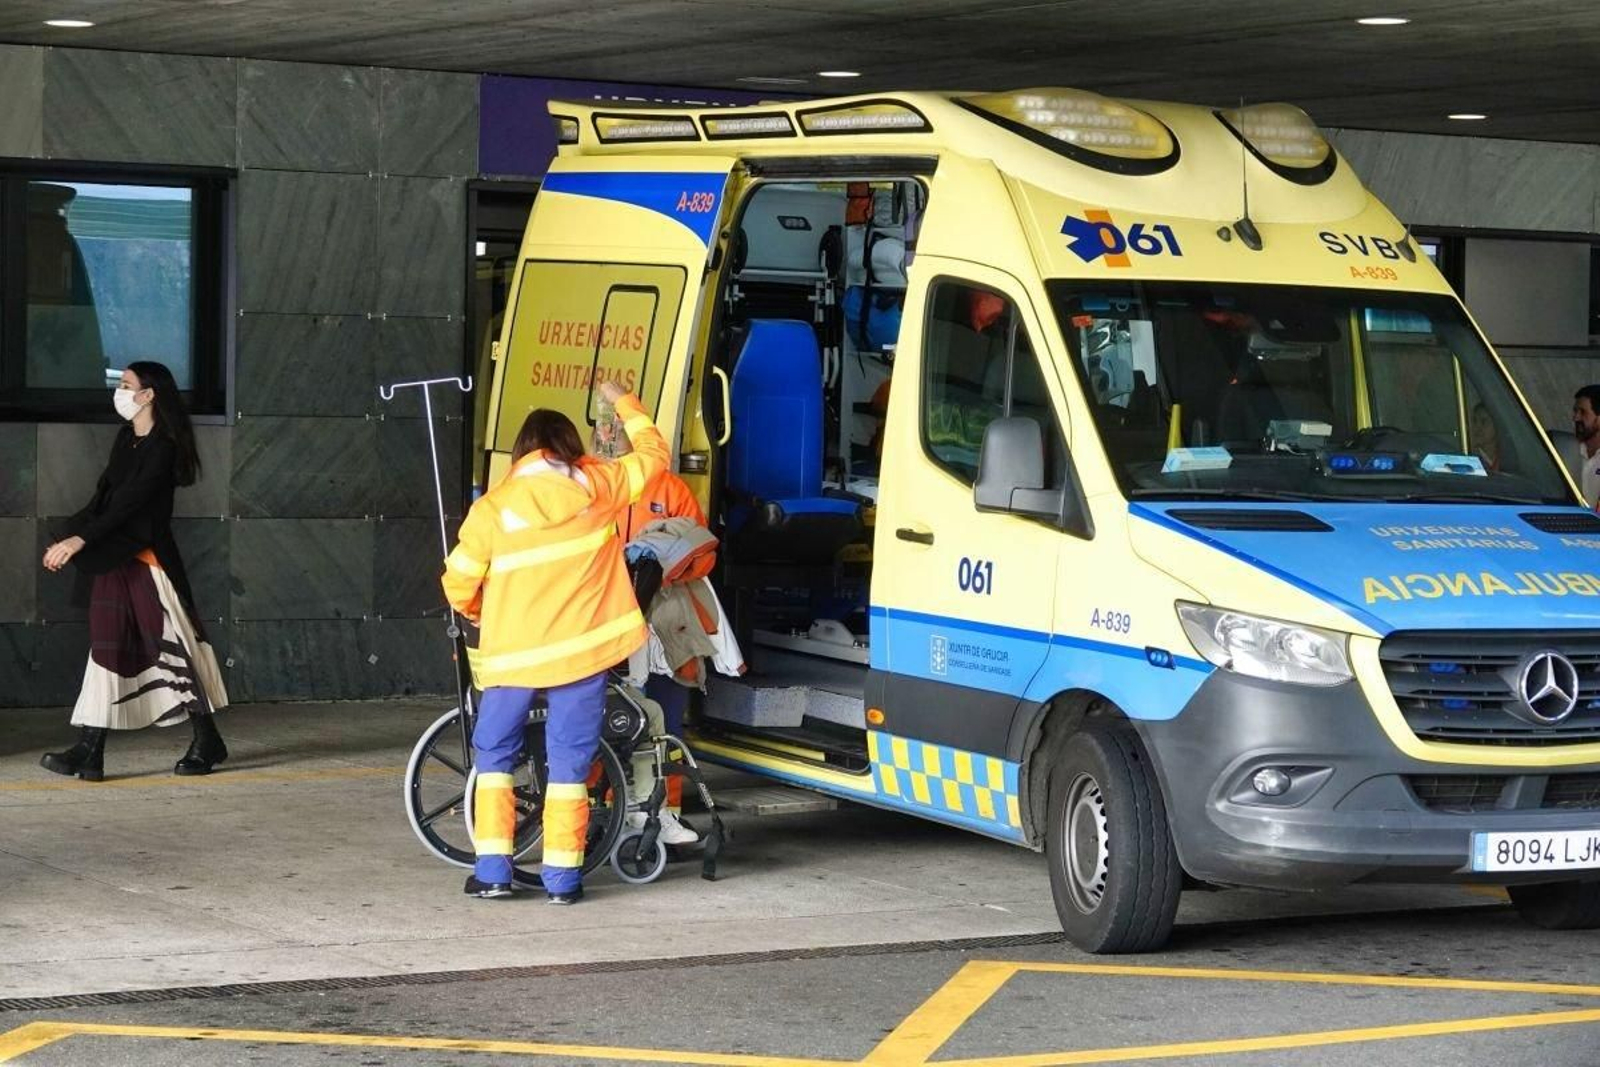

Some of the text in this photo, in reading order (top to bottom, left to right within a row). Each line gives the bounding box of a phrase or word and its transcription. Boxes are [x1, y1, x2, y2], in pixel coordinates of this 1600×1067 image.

[676, 191, 715, 213] A-839
[1318, 231, 1401, 260] SVB
[1350, 265, 1398, 281] A-839
[539, 320, 645, 350] URXENCIAS
[1368, 525, 1520, 537] URXENCIAS
[1392, 538, 1540, 550] SANITARIAS
[958, 557, 993, 595] 061
[1090, 608, 1131, 634] A-839
[971, 646, 980, 657] DE
[1496, 838, 1555, 864] 8094
